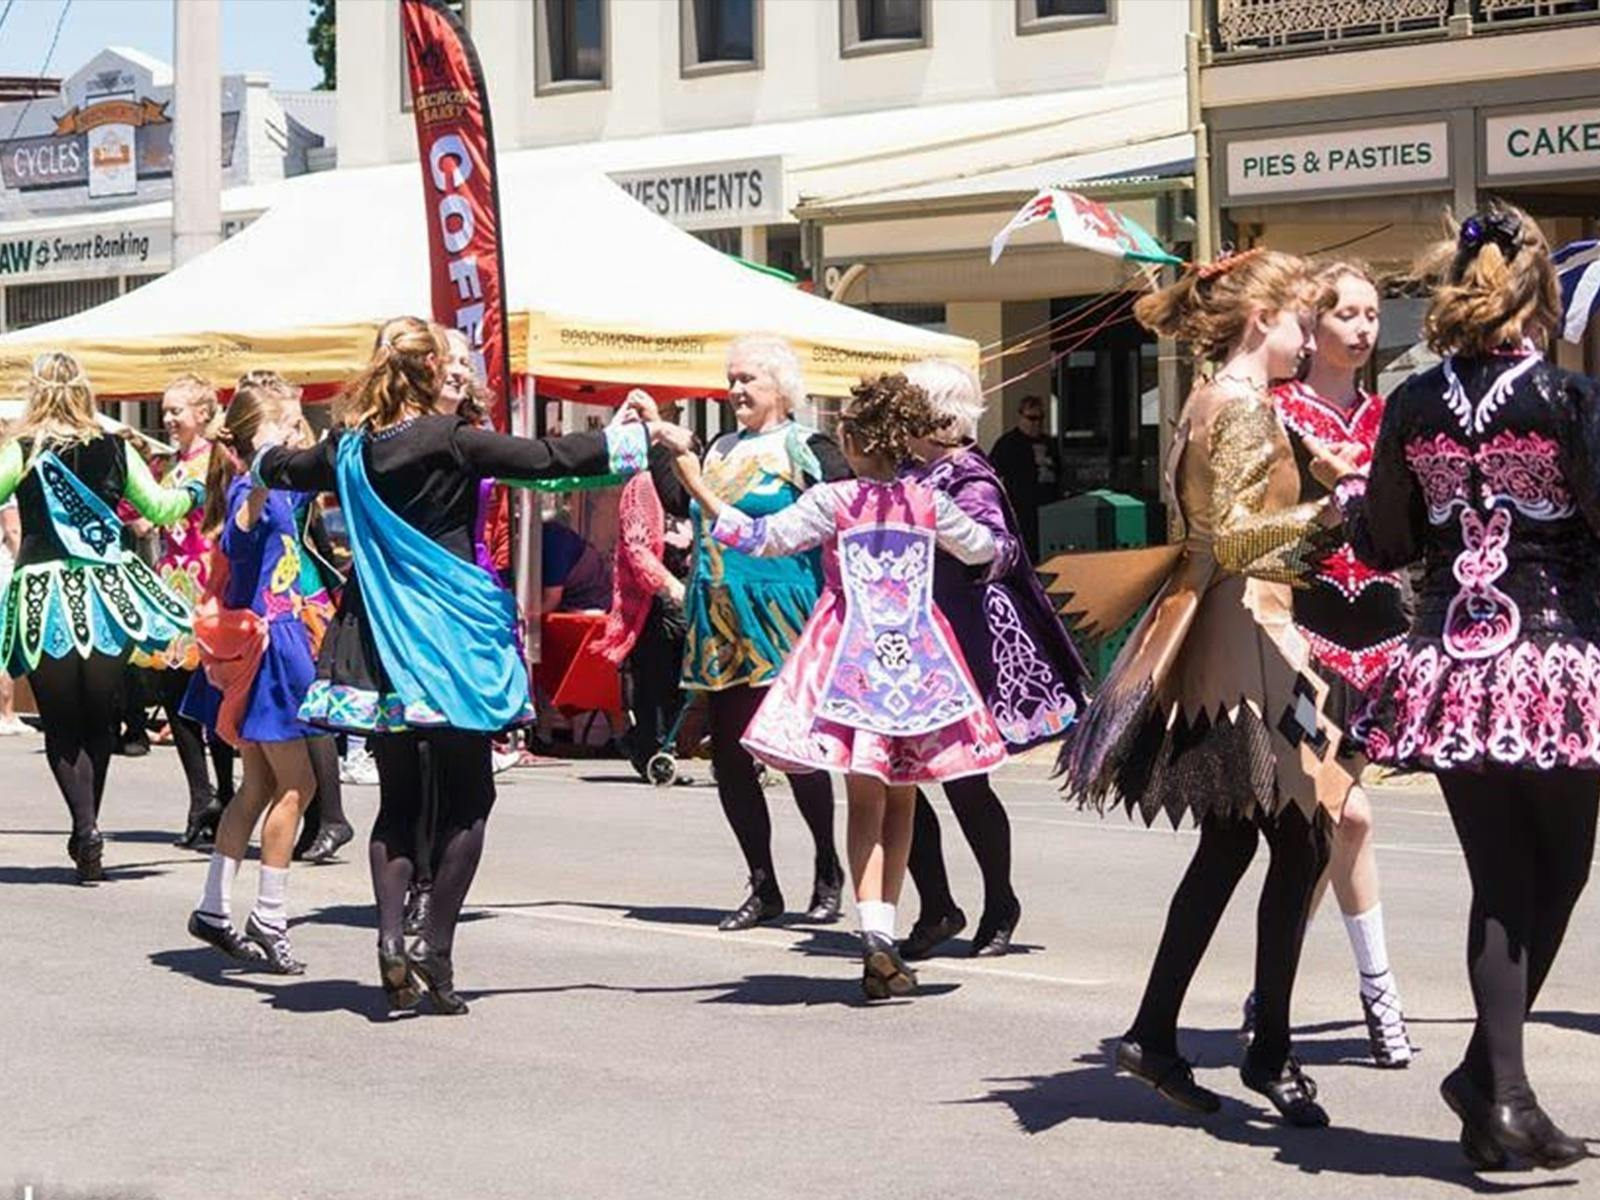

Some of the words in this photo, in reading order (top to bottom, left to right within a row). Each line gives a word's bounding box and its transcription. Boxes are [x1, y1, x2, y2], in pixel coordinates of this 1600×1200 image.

[1507, 123, 1600, 158] CAKE
[13, 142, 80, 177] CYCLES
[1243, 154, 1295, 179] PIES
[1303, 151, 1320, 174] &
[1329, 142, 1432, 171] PASTIES
[622, 170, 762, 215] VESTMENTS
[52, 237, 92, 262] Smart
[94, 231, 149, 262] Banking
[429, 134, 488, 388] COFF
